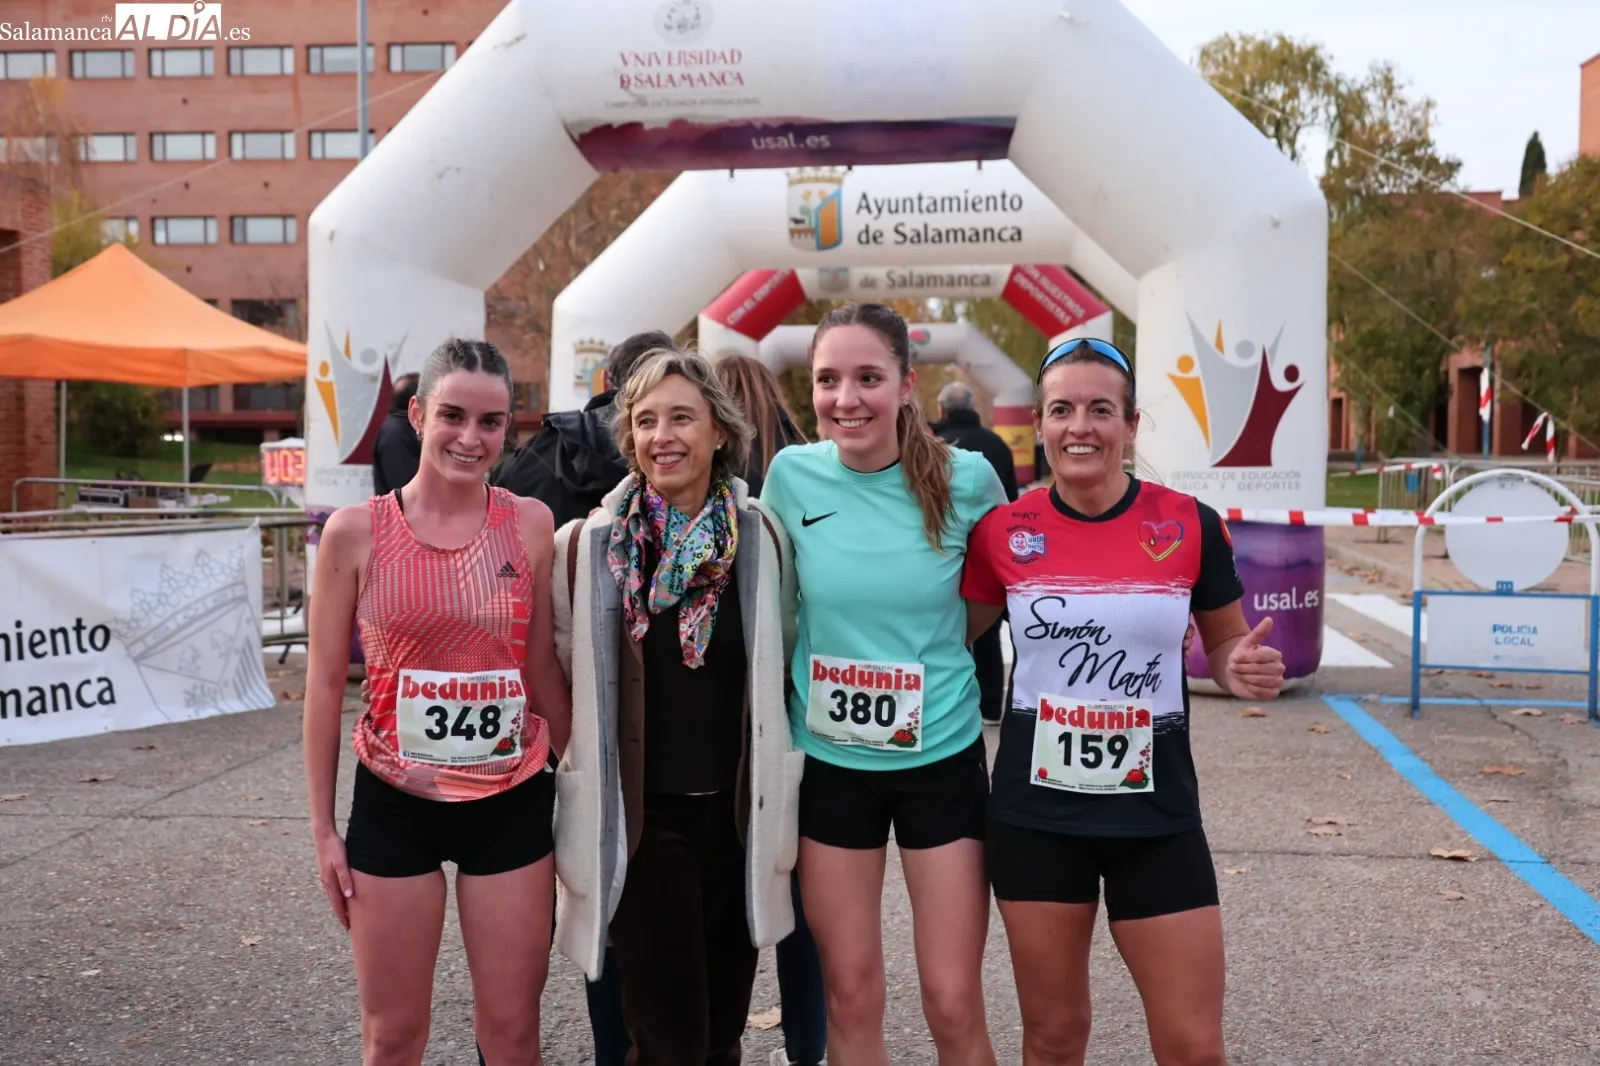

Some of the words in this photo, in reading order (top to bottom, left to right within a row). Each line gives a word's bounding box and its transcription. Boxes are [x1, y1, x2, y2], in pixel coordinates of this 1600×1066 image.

[751, 132, 831, 151] usal.es
[856, 190, 1024, 220] Ayuntamiento
[857, 225, 885, 245] de
[894, 223, 1023, 244] Salamanca
[858, 273, 878, 290] de
[885, 270, 991, 290] Salamanca
[1171, 471, 1220, 480] SERVICIO
[1222, 471, 1236, 480] DE
[1238, 481, 1301, 491] DEPORTES
[1253, 587, 1320, 611] usal.es
[1024, 596, 1111, 645] Simón
[1494, 636, 1534, 647] LOCAL
[812, 659, 921, 691] bedunia
[1059, 642, 1162, 699] Martín
[401, 675, 525, 700] bedunia
[828, 689, 897, 728] 380
[1039, 698, 1151, 730] bedunia
[425, 704, 502, 741] 348
[1057, 731, 1129, 770] 159
